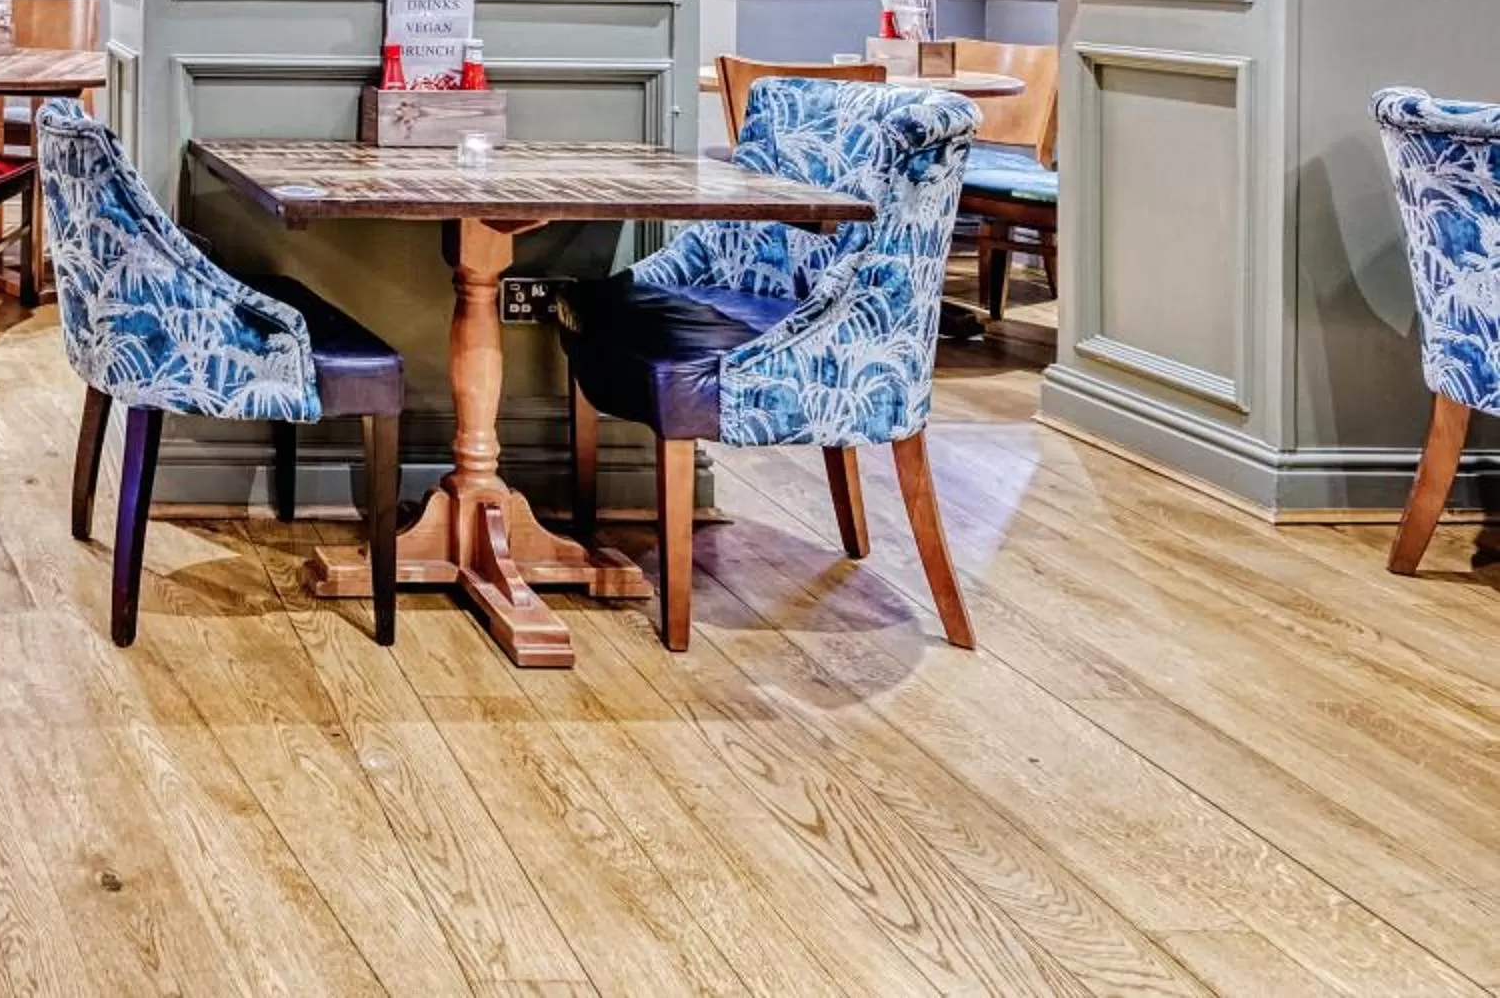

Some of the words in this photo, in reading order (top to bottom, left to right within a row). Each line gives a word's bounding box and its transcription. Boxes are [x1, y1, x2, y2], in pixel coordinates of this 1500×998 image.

[407, 0, 461, 11] DRINKS
[404, 21, 452, 34] VEGAN
[402, 45, 455, 57] RUNCH
